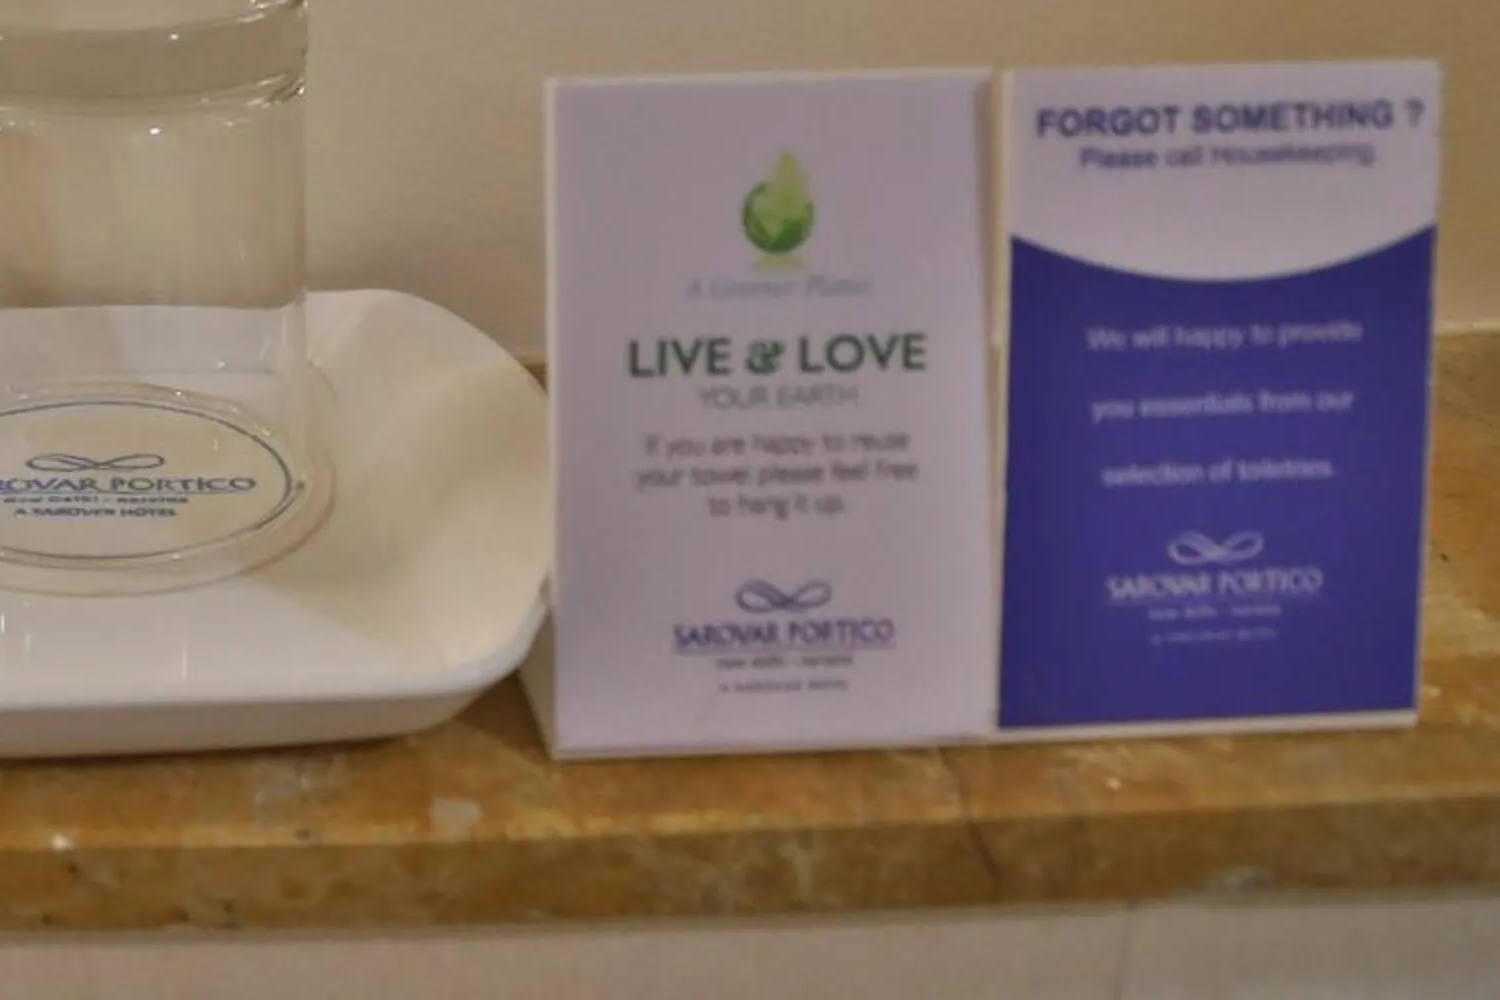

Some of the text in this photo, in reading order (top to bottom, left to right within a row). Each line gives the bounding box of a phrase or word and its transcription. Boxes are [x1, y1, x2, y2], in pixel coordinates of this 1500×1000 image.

[1036, 97, 1426, 138] FORGOT SOMETHING ?
[1080, 146, 1157, 168] Please
[1086, 326, 1126, 351] We
[1174, 325, 1243, 351] happy
[1250, 324, 1274, 346] to
[1277, 321, 1363, 348] provide
[627, 334, 927, 377] LIVE & LOVE
[110, 477, 257, 491] PORTICO
